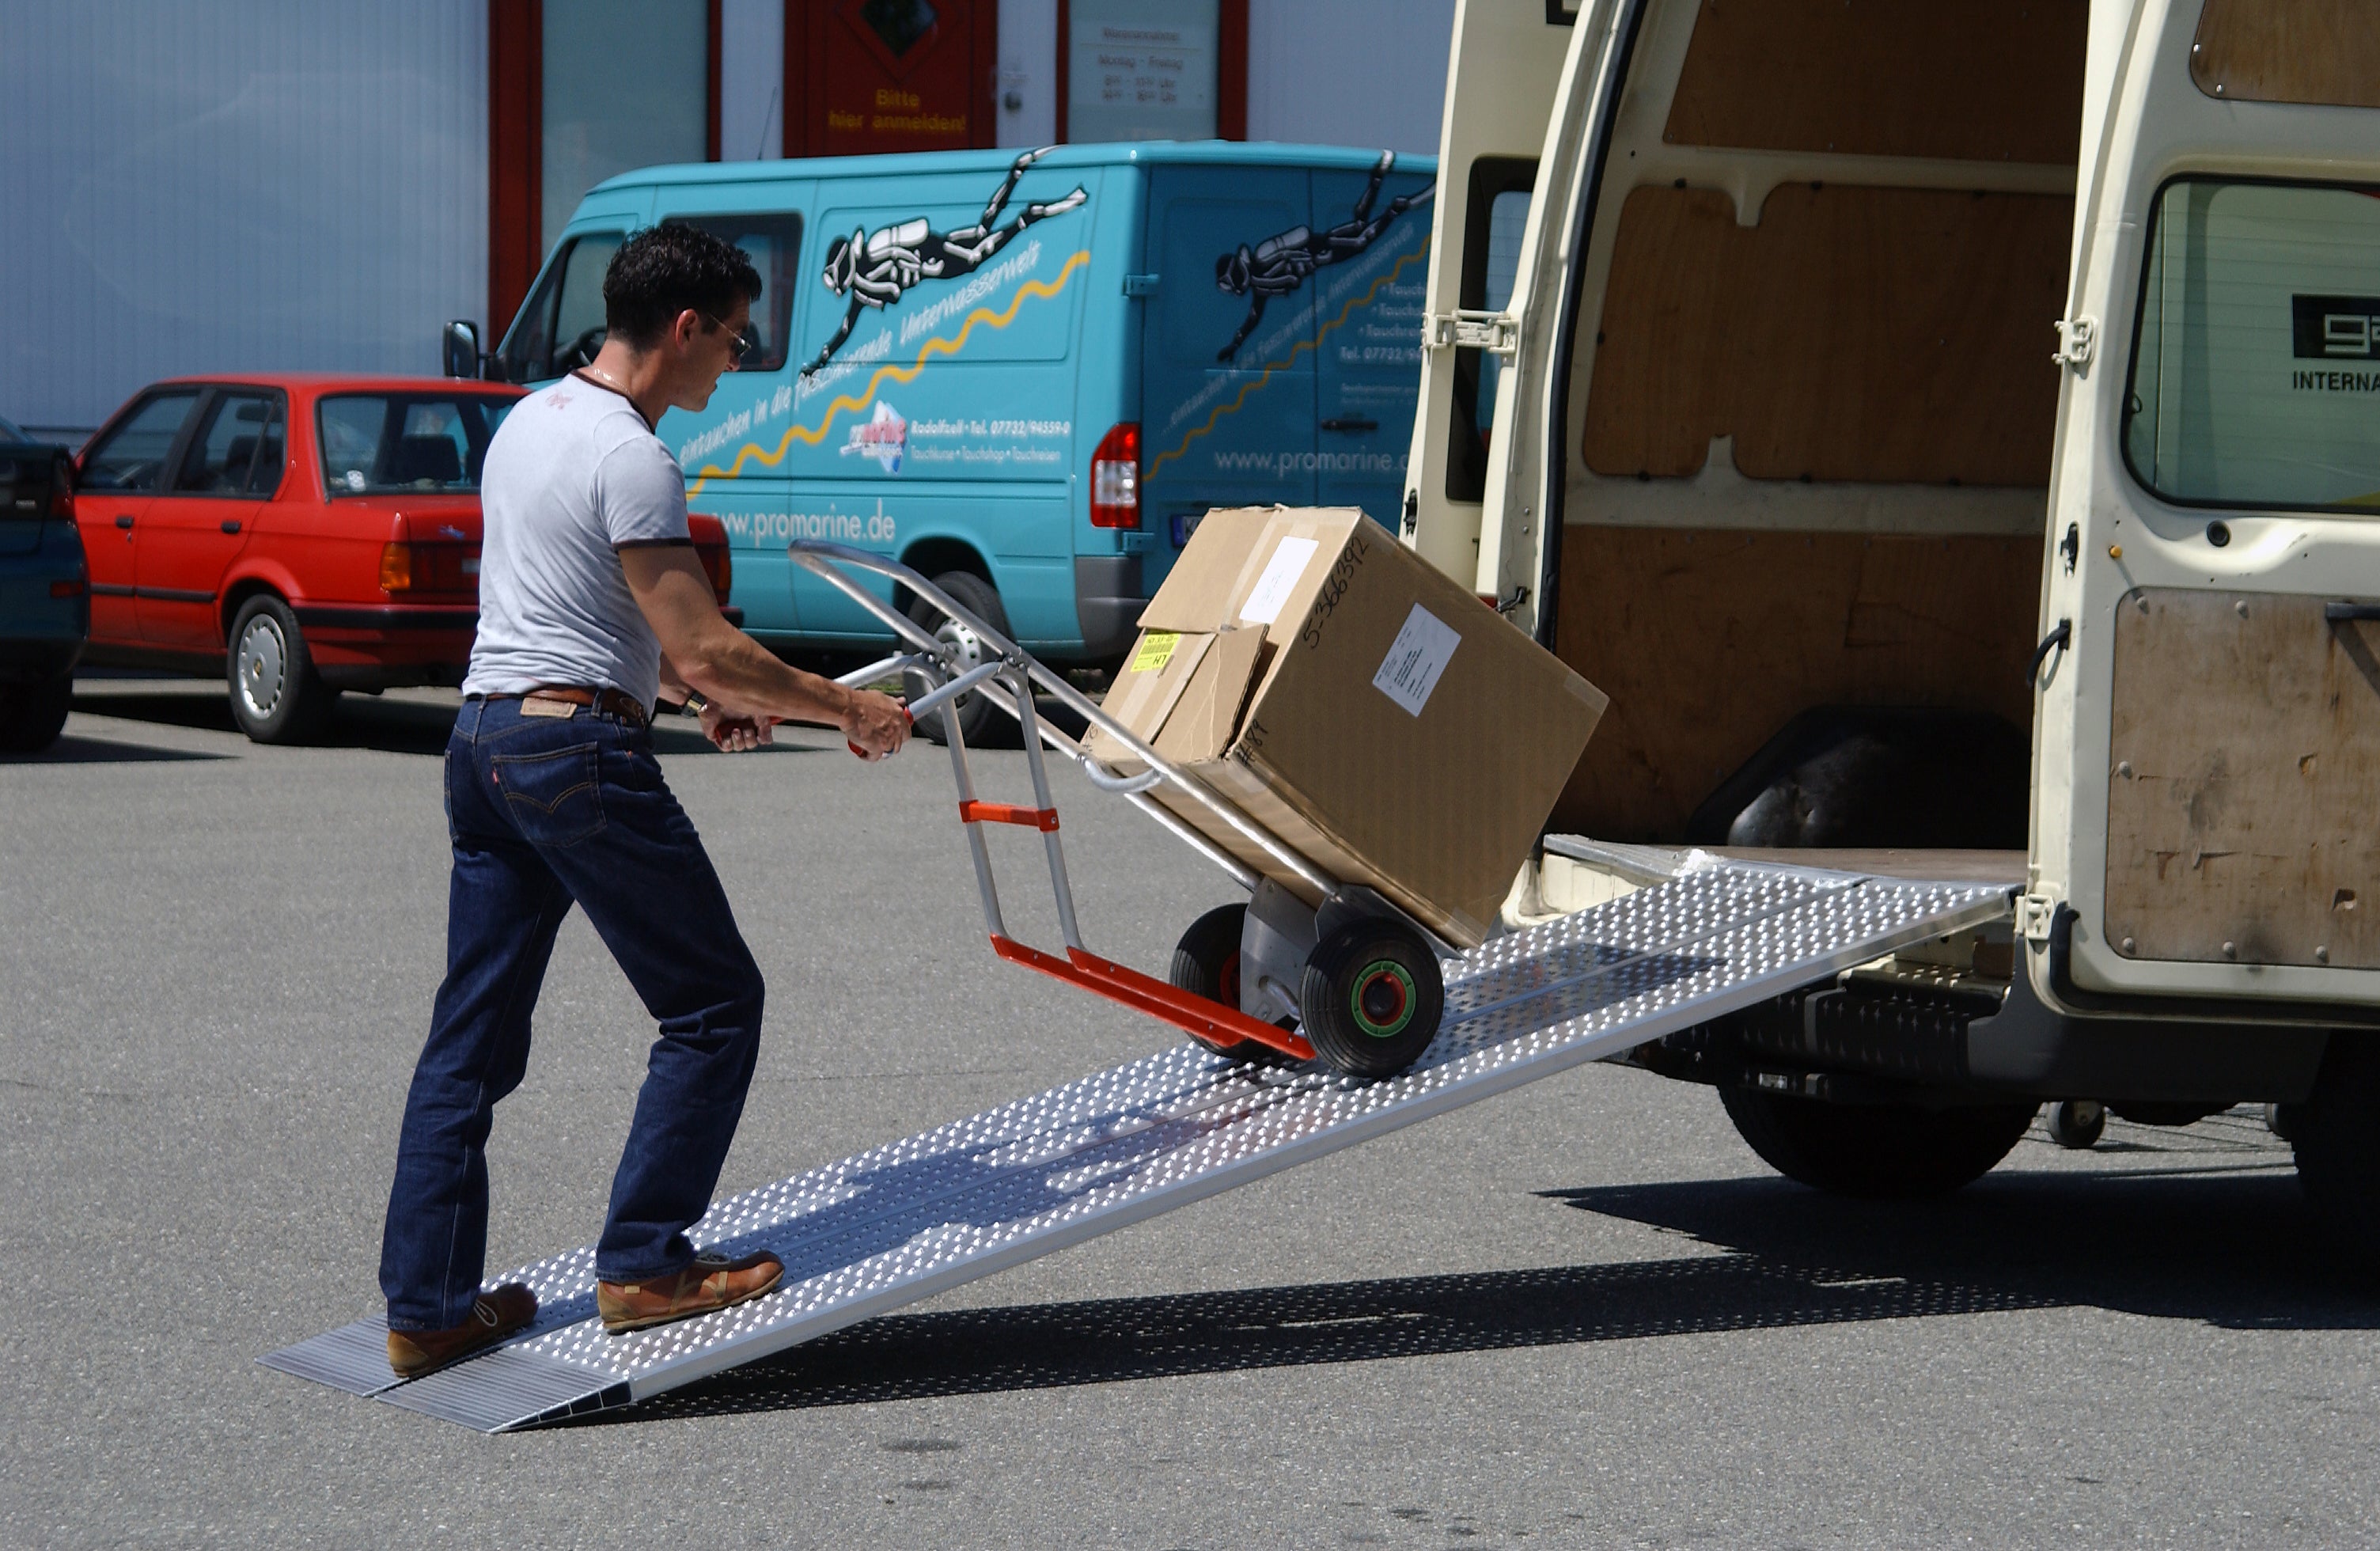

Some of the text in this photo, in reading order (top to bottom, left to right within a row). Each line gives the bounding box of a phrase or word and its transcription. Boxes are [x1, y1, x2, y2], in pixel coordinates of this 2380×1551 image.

[876, 88, 921, 108] Bitte
[828, 110, 967, 133] hier anmelden!
[1389, 283, 1425, 297] Tauch
[679, 408, 751, 468] eintauchen
[753, 398, 768, 427] in
[771, 385, 792, 419] die
[900, 240, 1041, 347] Unterwasserwelt
[911, 419, 965, 436] Radolfzell
[969, 419, 988, 435] Tel.
[711, 497, 896, 548] ww.promarine.de
[1302, 536, 1370, 650] 5-366392
